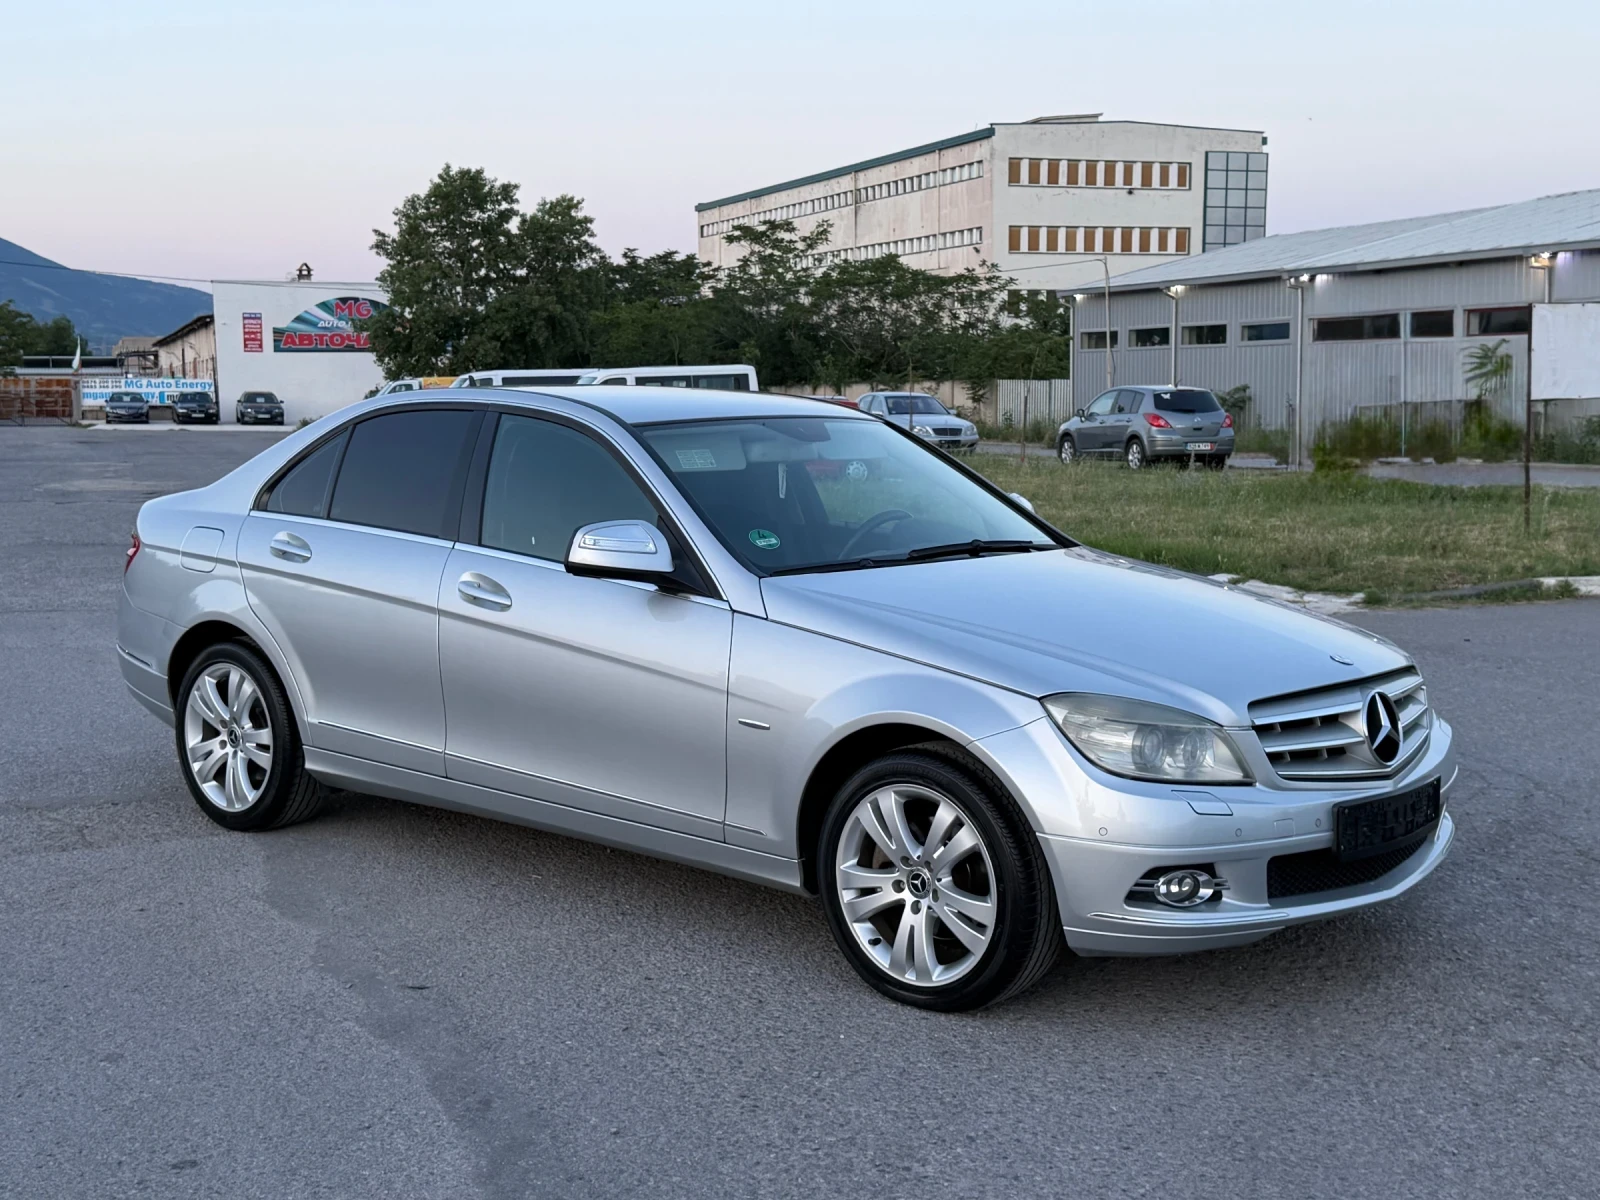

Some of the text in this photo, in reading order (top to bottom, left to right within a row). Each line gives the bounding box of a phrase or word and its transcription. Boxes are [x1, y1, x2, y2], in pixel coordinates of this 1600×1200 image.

[334, 300, 372, 319] MG
[317, 320, 346, 328] AUTO
[124, 380, 213, 391] MG Auto Energy
